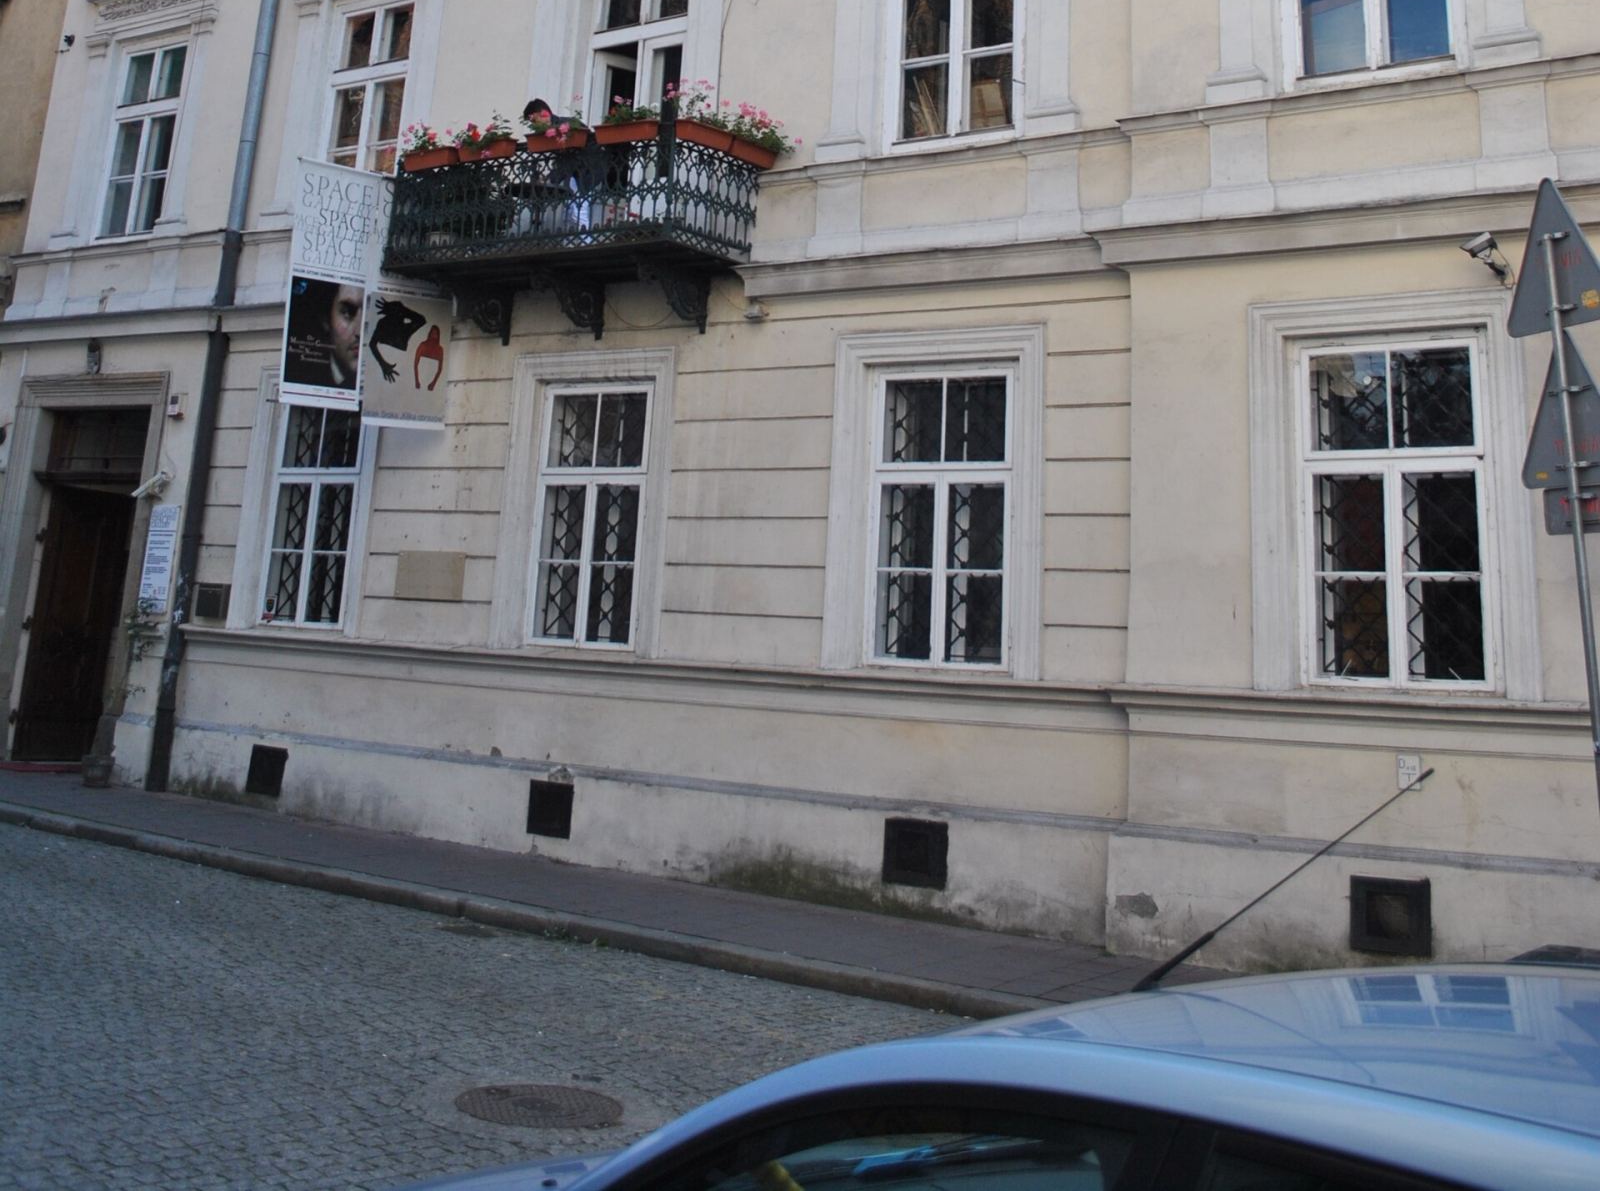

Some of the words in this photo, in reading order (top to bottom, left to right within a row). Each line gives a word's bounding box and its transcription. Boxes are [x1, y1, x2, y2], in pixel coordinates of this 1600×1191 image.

[303, 173, 374, 206] SPACE
[319, 208, 371, 234] SPACE
[303, 232, 362, 259] SPACE
[302, 250, 362, 271] GALLERY
